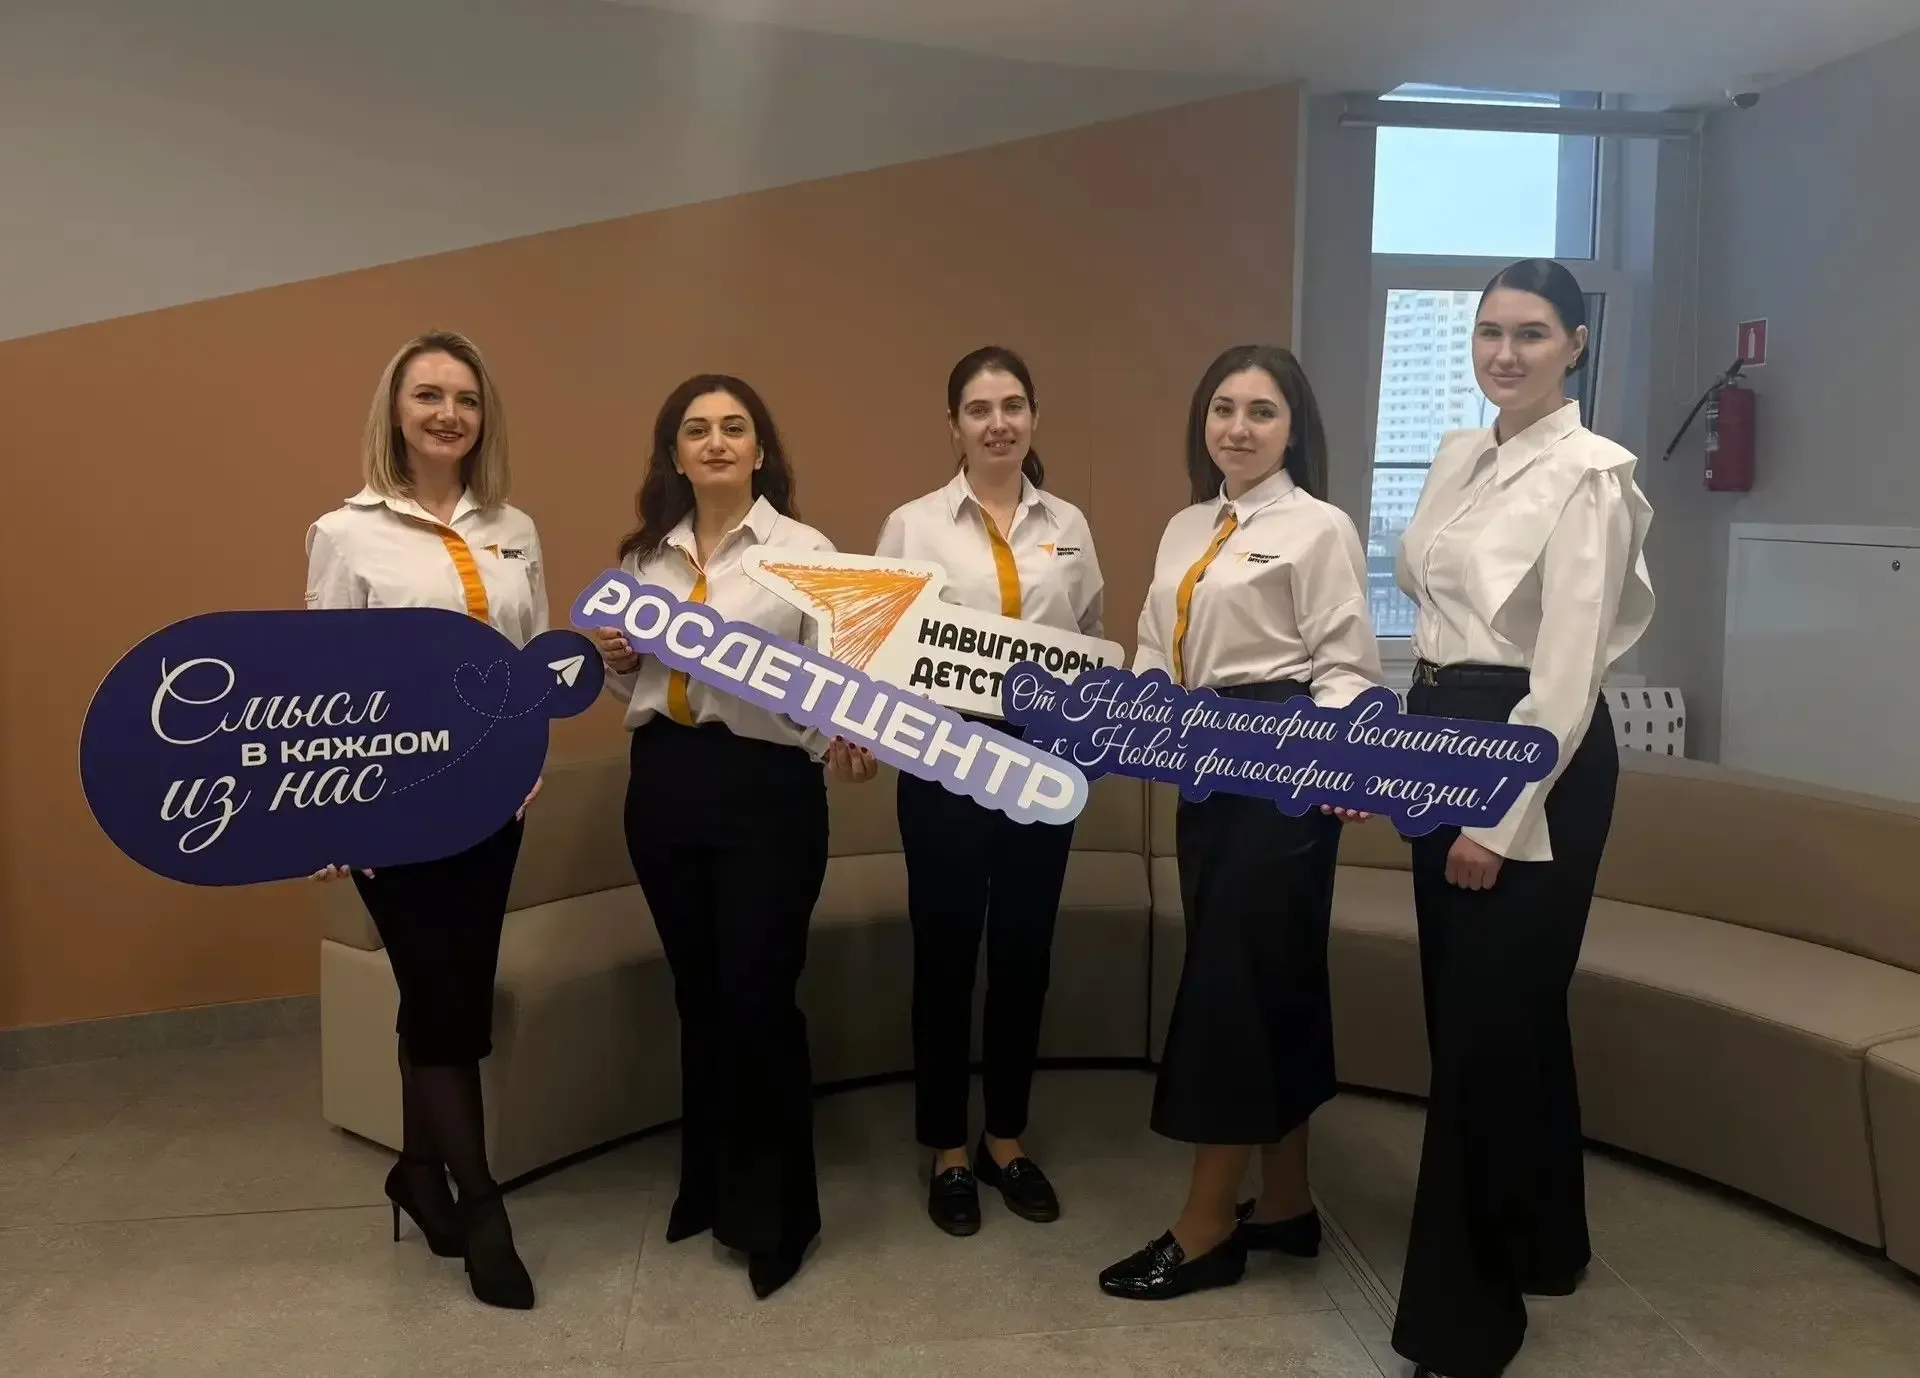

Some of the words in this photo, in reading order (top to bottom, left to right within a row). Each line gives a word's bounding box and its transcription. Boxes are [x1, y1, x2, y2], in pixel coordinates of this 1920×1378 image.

[150, 656, 391, 745] Смысл
[582, 578, 1076, 810] РОСДЕТЦЕНТР
[909, 656, 1004, 698] ДЕТСТ
[1012, 673, 1057, 712] От
[1061, 679, 1174, 725] Новой
[1180, 700, 1338, 750] философии
[1344, 700, 1542, 764] воспитания
[241, 742, 268, 767] В
[280, 729, 451, 765] КАЖДОМ
[1072, 724, 1188, 771] Новой
[1193, 747, 1355, 800] философии
[1364, 776, 1509, 818] жизни!
[160, 776, 252, 854] из
[268, 763, 388, 811] нас
